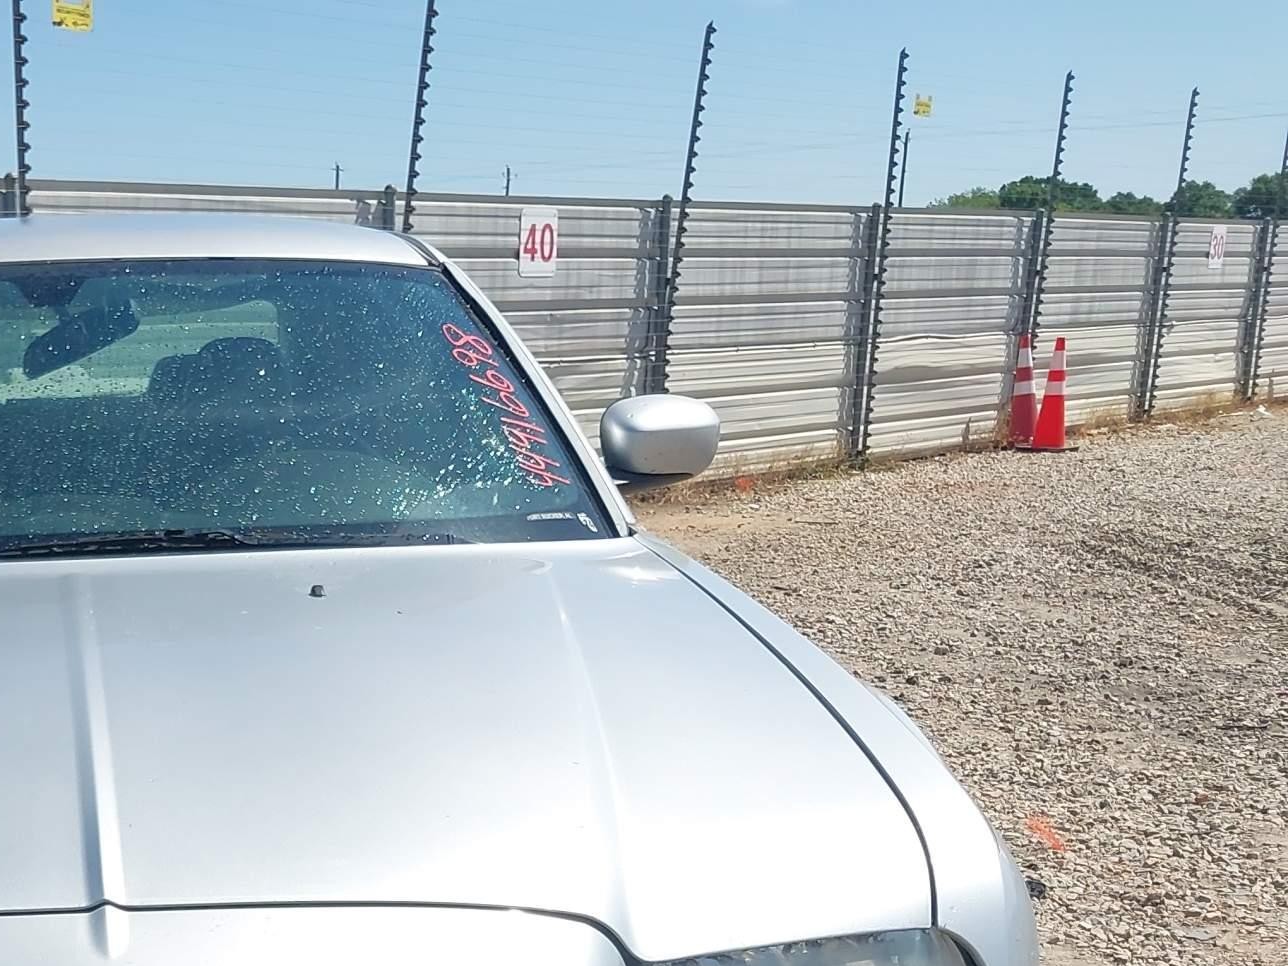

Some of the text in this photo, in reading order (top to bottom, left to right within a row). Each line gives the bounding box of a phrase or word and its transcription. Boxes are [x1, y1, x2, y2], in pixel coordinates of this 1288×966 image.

[523, 223, 554, 262] 40
[1210, 235, 1224, 260] 30
[442, 323, 570, 487] 44916698
